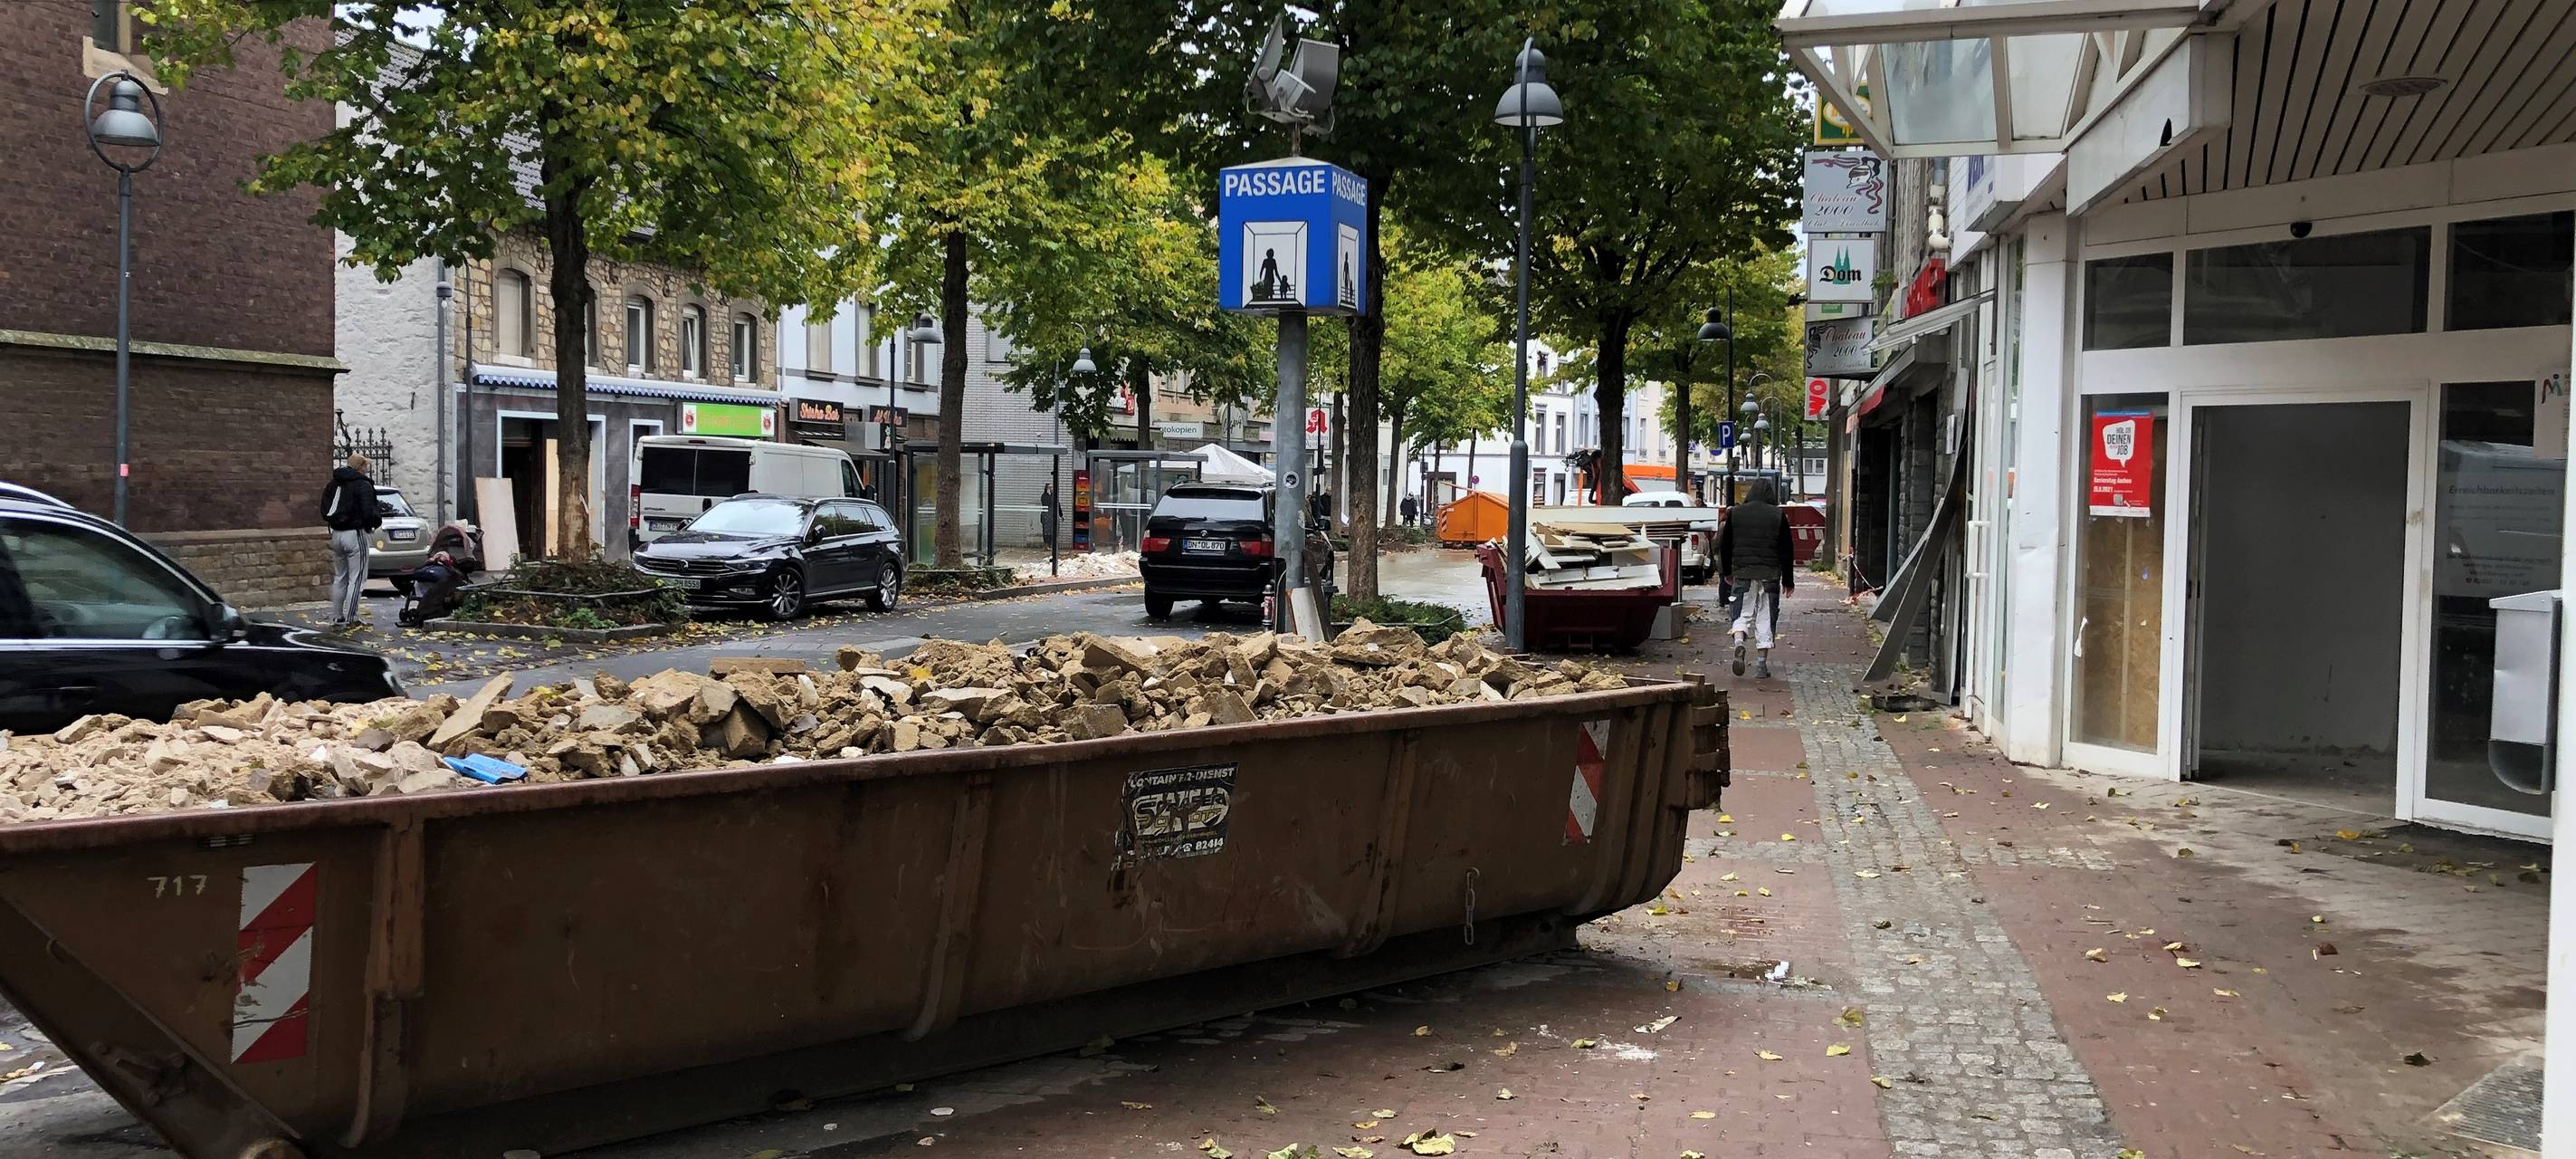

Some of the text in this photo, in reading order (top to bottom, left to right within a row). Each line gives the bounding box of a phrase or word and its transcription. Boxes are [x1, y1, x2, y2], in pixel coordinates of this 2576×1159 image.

[1225, 169, 1325, 197] PASSAGE
[1331, 171, 1366, 206] PASSAGE
[1810, 191, 1857, 204] Chateau
[1814, 205, 1854, 216] 2000
[1818, 265, 1863, 283] Dom
[1825, 327, 1866, 342] Chateau
[1833, 346, 1858, 358] 2000
[1159, 426, 1197, 435] otokopien
[1722, 425, 1731, 445] P
[2106, 435, 2132, 445] DEINEN
[2116, 445, 2129, 455] JOB
[1195, 837, 1224, 850] 82414
[146, 874, 208, 899] 717
